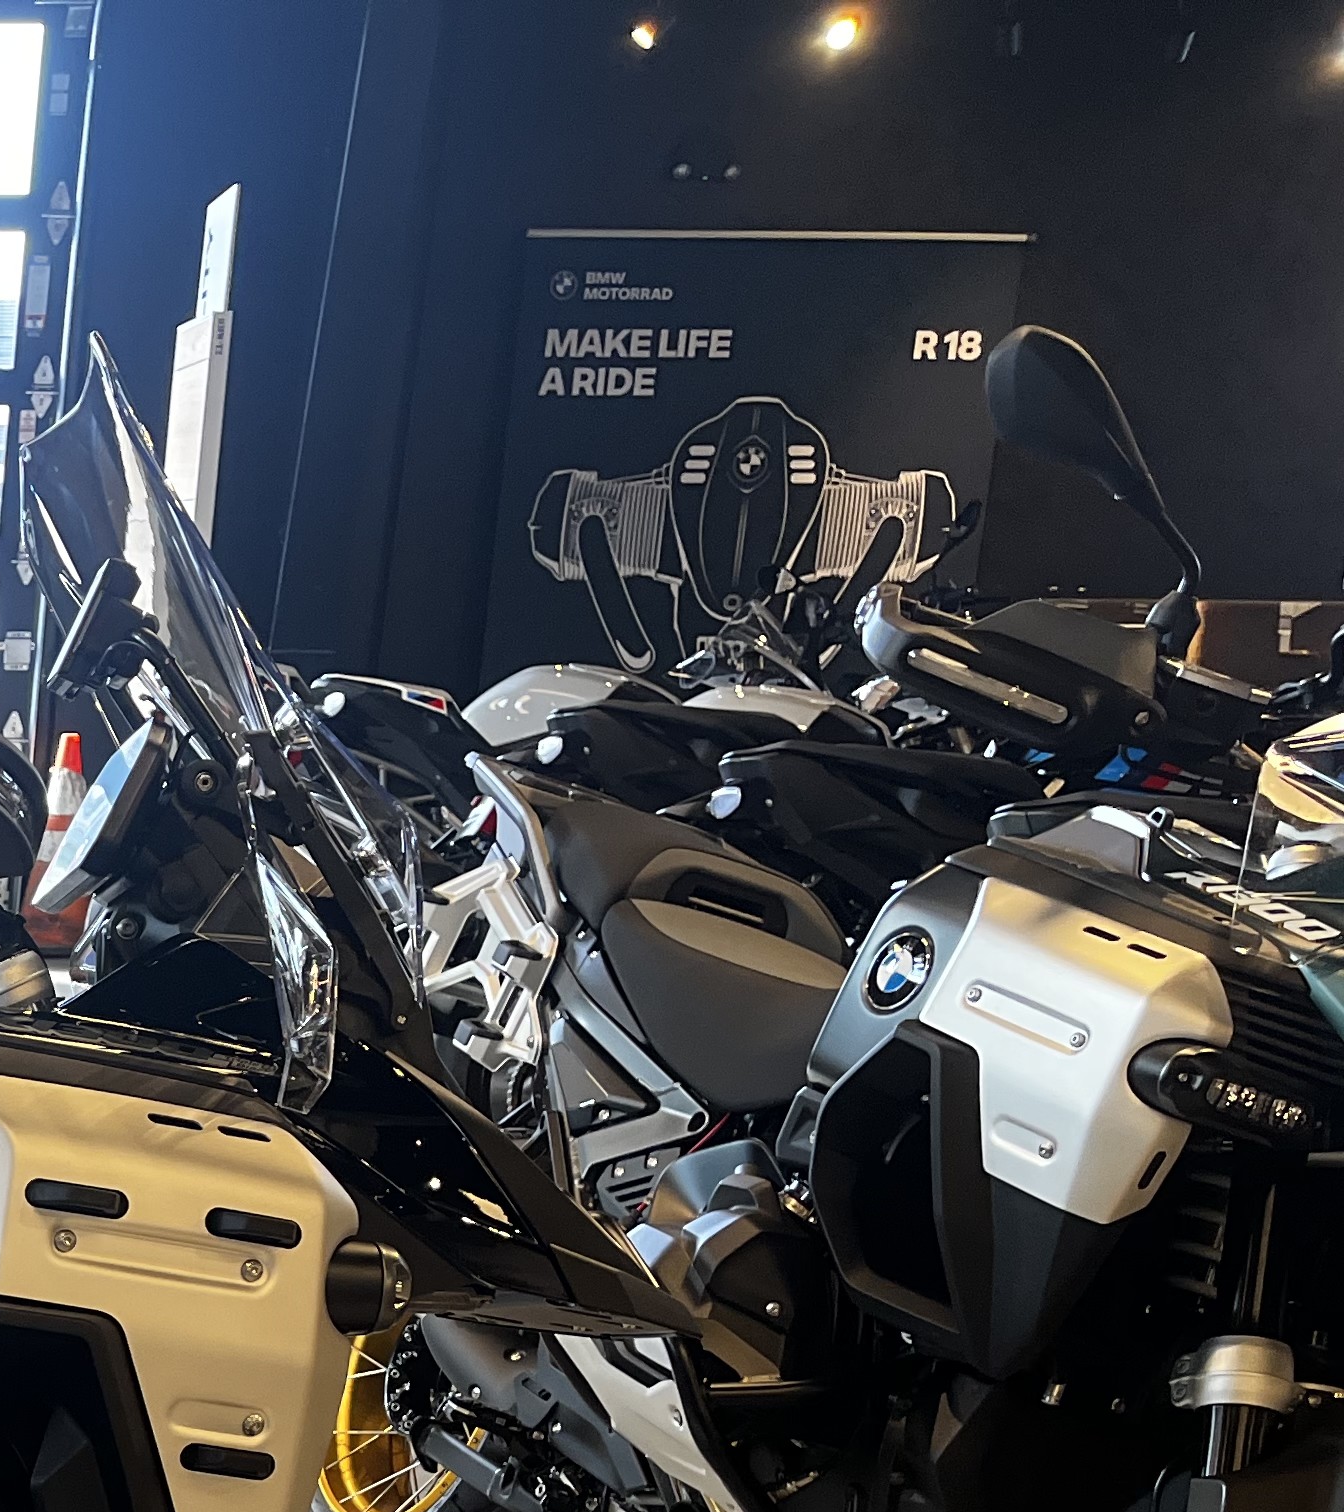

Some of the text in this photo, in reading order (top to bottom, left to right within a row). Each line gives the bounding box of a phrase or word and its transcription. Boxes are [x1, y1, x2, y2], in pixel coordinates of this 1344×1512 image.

[585, 271, 626, 284] BMW
[583, 287, 673, 300] MOTORRAD
[544, 328, 733, 358] MAKE LIFE
[912, 329, 983, 361] R 18
[538, 366, 657, 396] A RIDE
